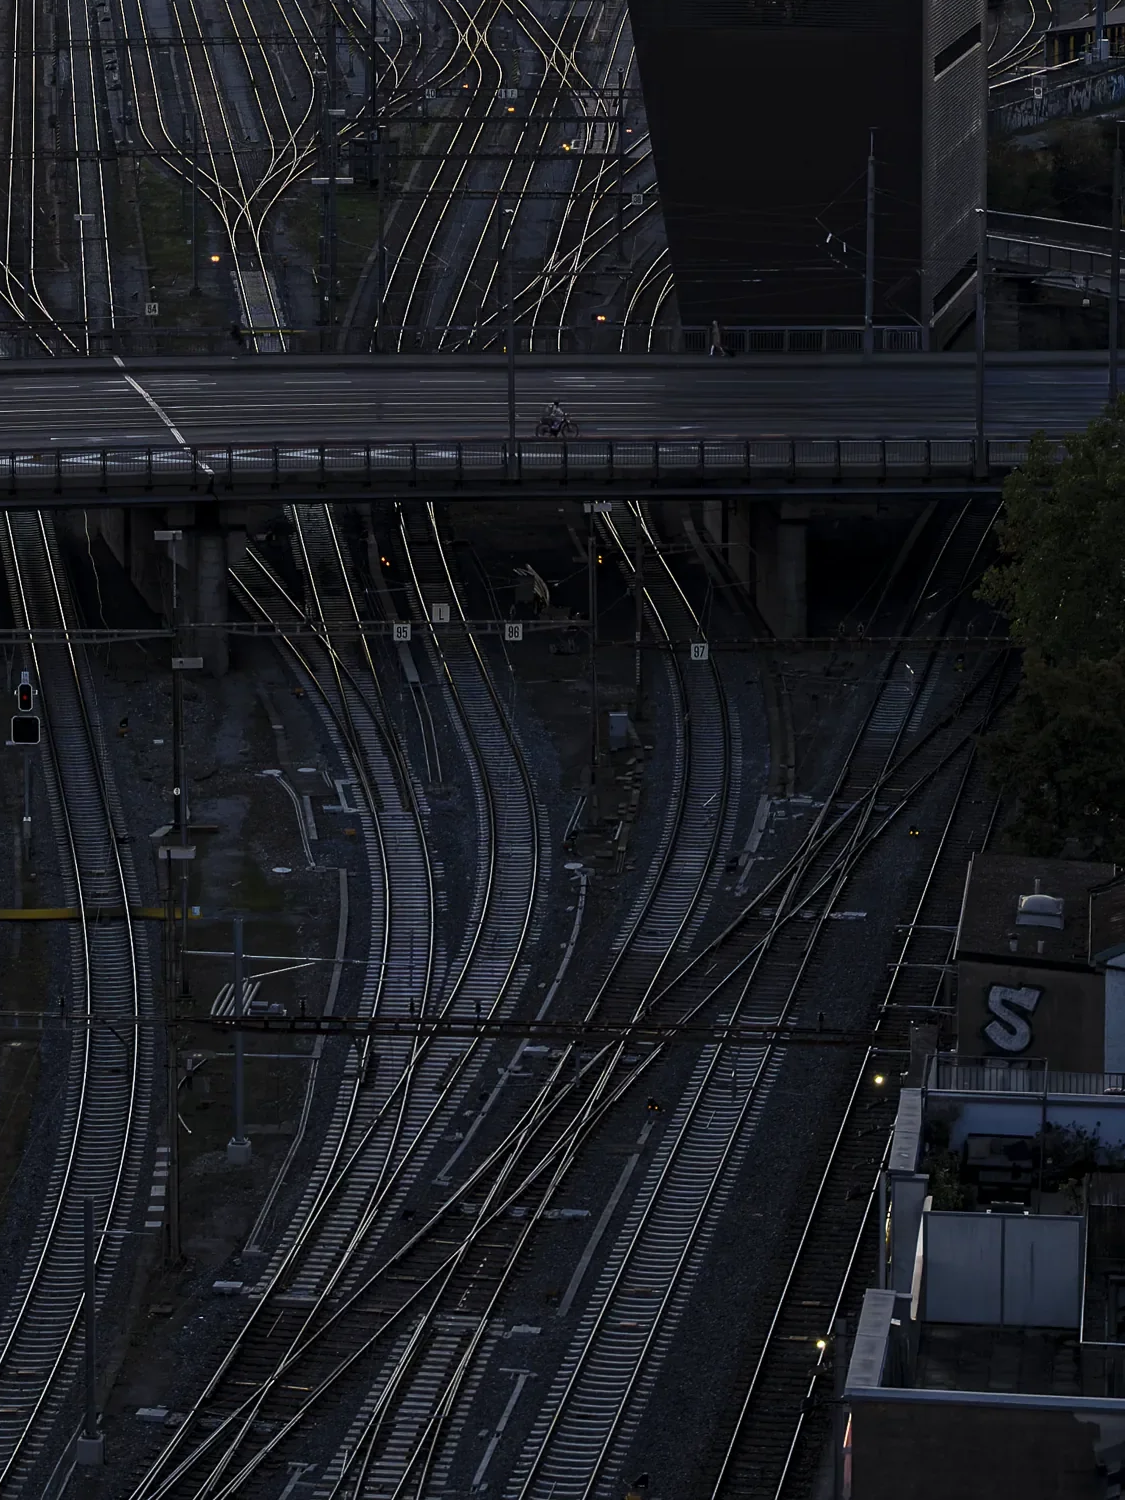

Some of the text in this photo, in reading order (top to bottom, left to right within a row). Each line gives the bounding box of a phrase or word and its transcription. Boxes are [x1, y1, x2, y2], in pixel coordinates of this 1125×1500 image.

[438, 608, 445, 620] L
[396, 626, 408, 638] 95
[508, 626, 520, 638] 96
[693, 645, 705, 658] 97
[983, 984, 1042, 1053] S
